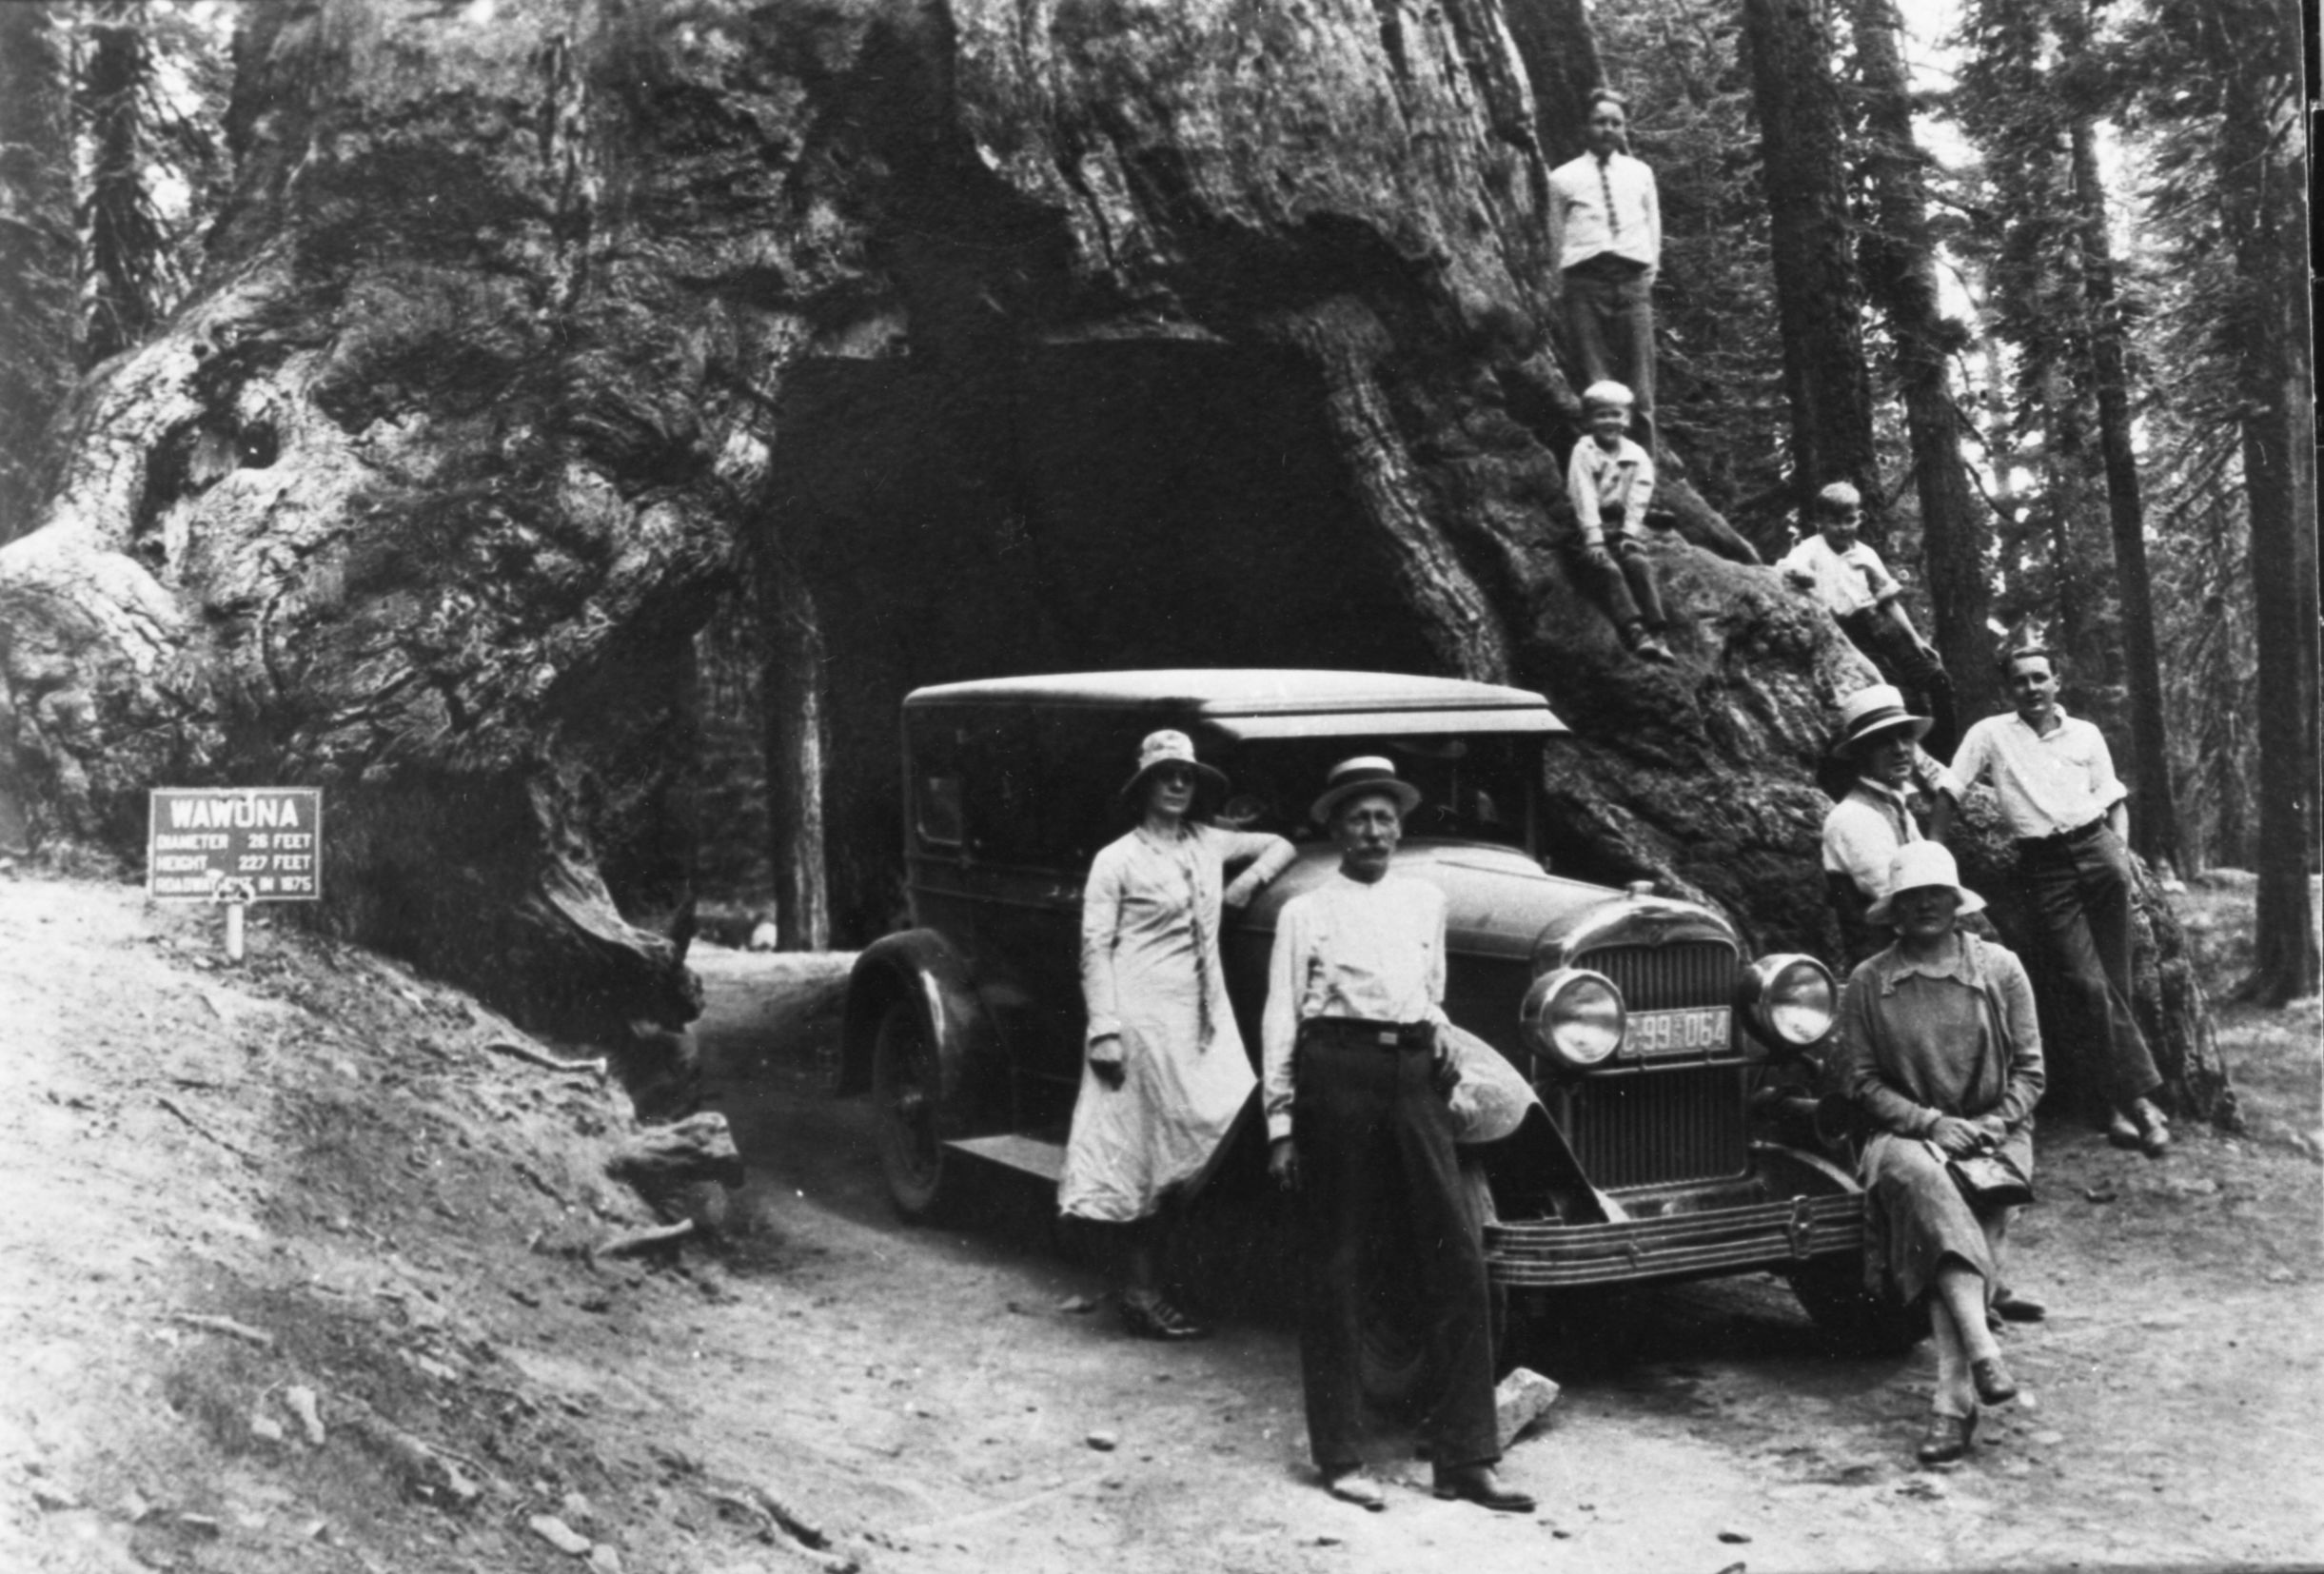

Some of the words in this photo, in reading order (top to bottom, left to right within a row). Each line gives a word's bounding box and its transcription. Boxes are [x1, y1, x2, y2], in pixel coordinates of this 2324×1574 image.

[170, 798, 299, 828] WAWONA
[156, 833, 228, 850] DIAMETER
[272, 833, 312, 849] FEET
[156, 855, 208, 871] HEIGHT
[238, 855, 268, 871] 227
[272, 855, 312, 870] FEET
[259, 876, 274, 892] IN
[280, 876, 312, 892] 1875
